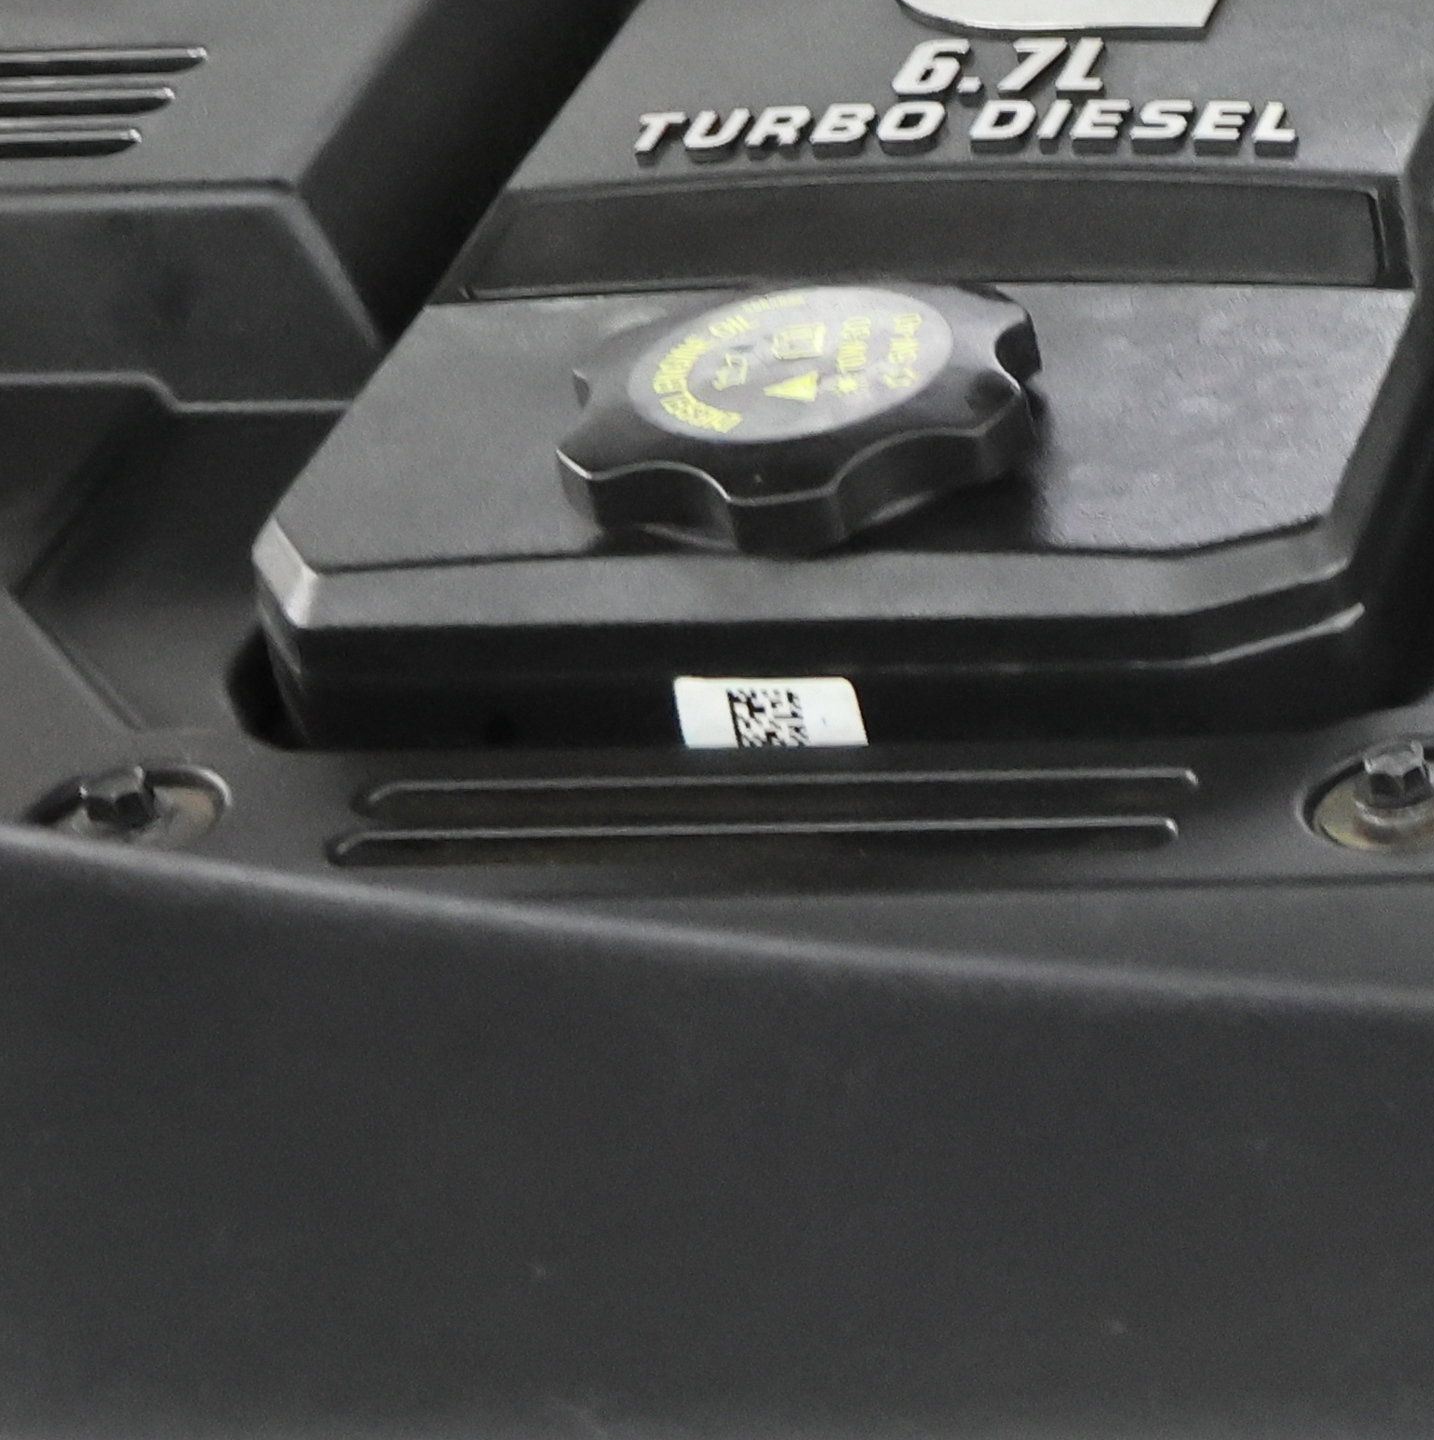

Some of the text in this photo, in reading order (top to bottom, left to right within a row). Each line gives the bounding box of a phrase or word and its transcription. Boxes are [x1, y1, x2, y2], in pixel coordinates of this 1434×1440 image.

[892, 37, 1104, 98] 6.7L
[634, 98, 1299, 156] TURBO DIESEL
